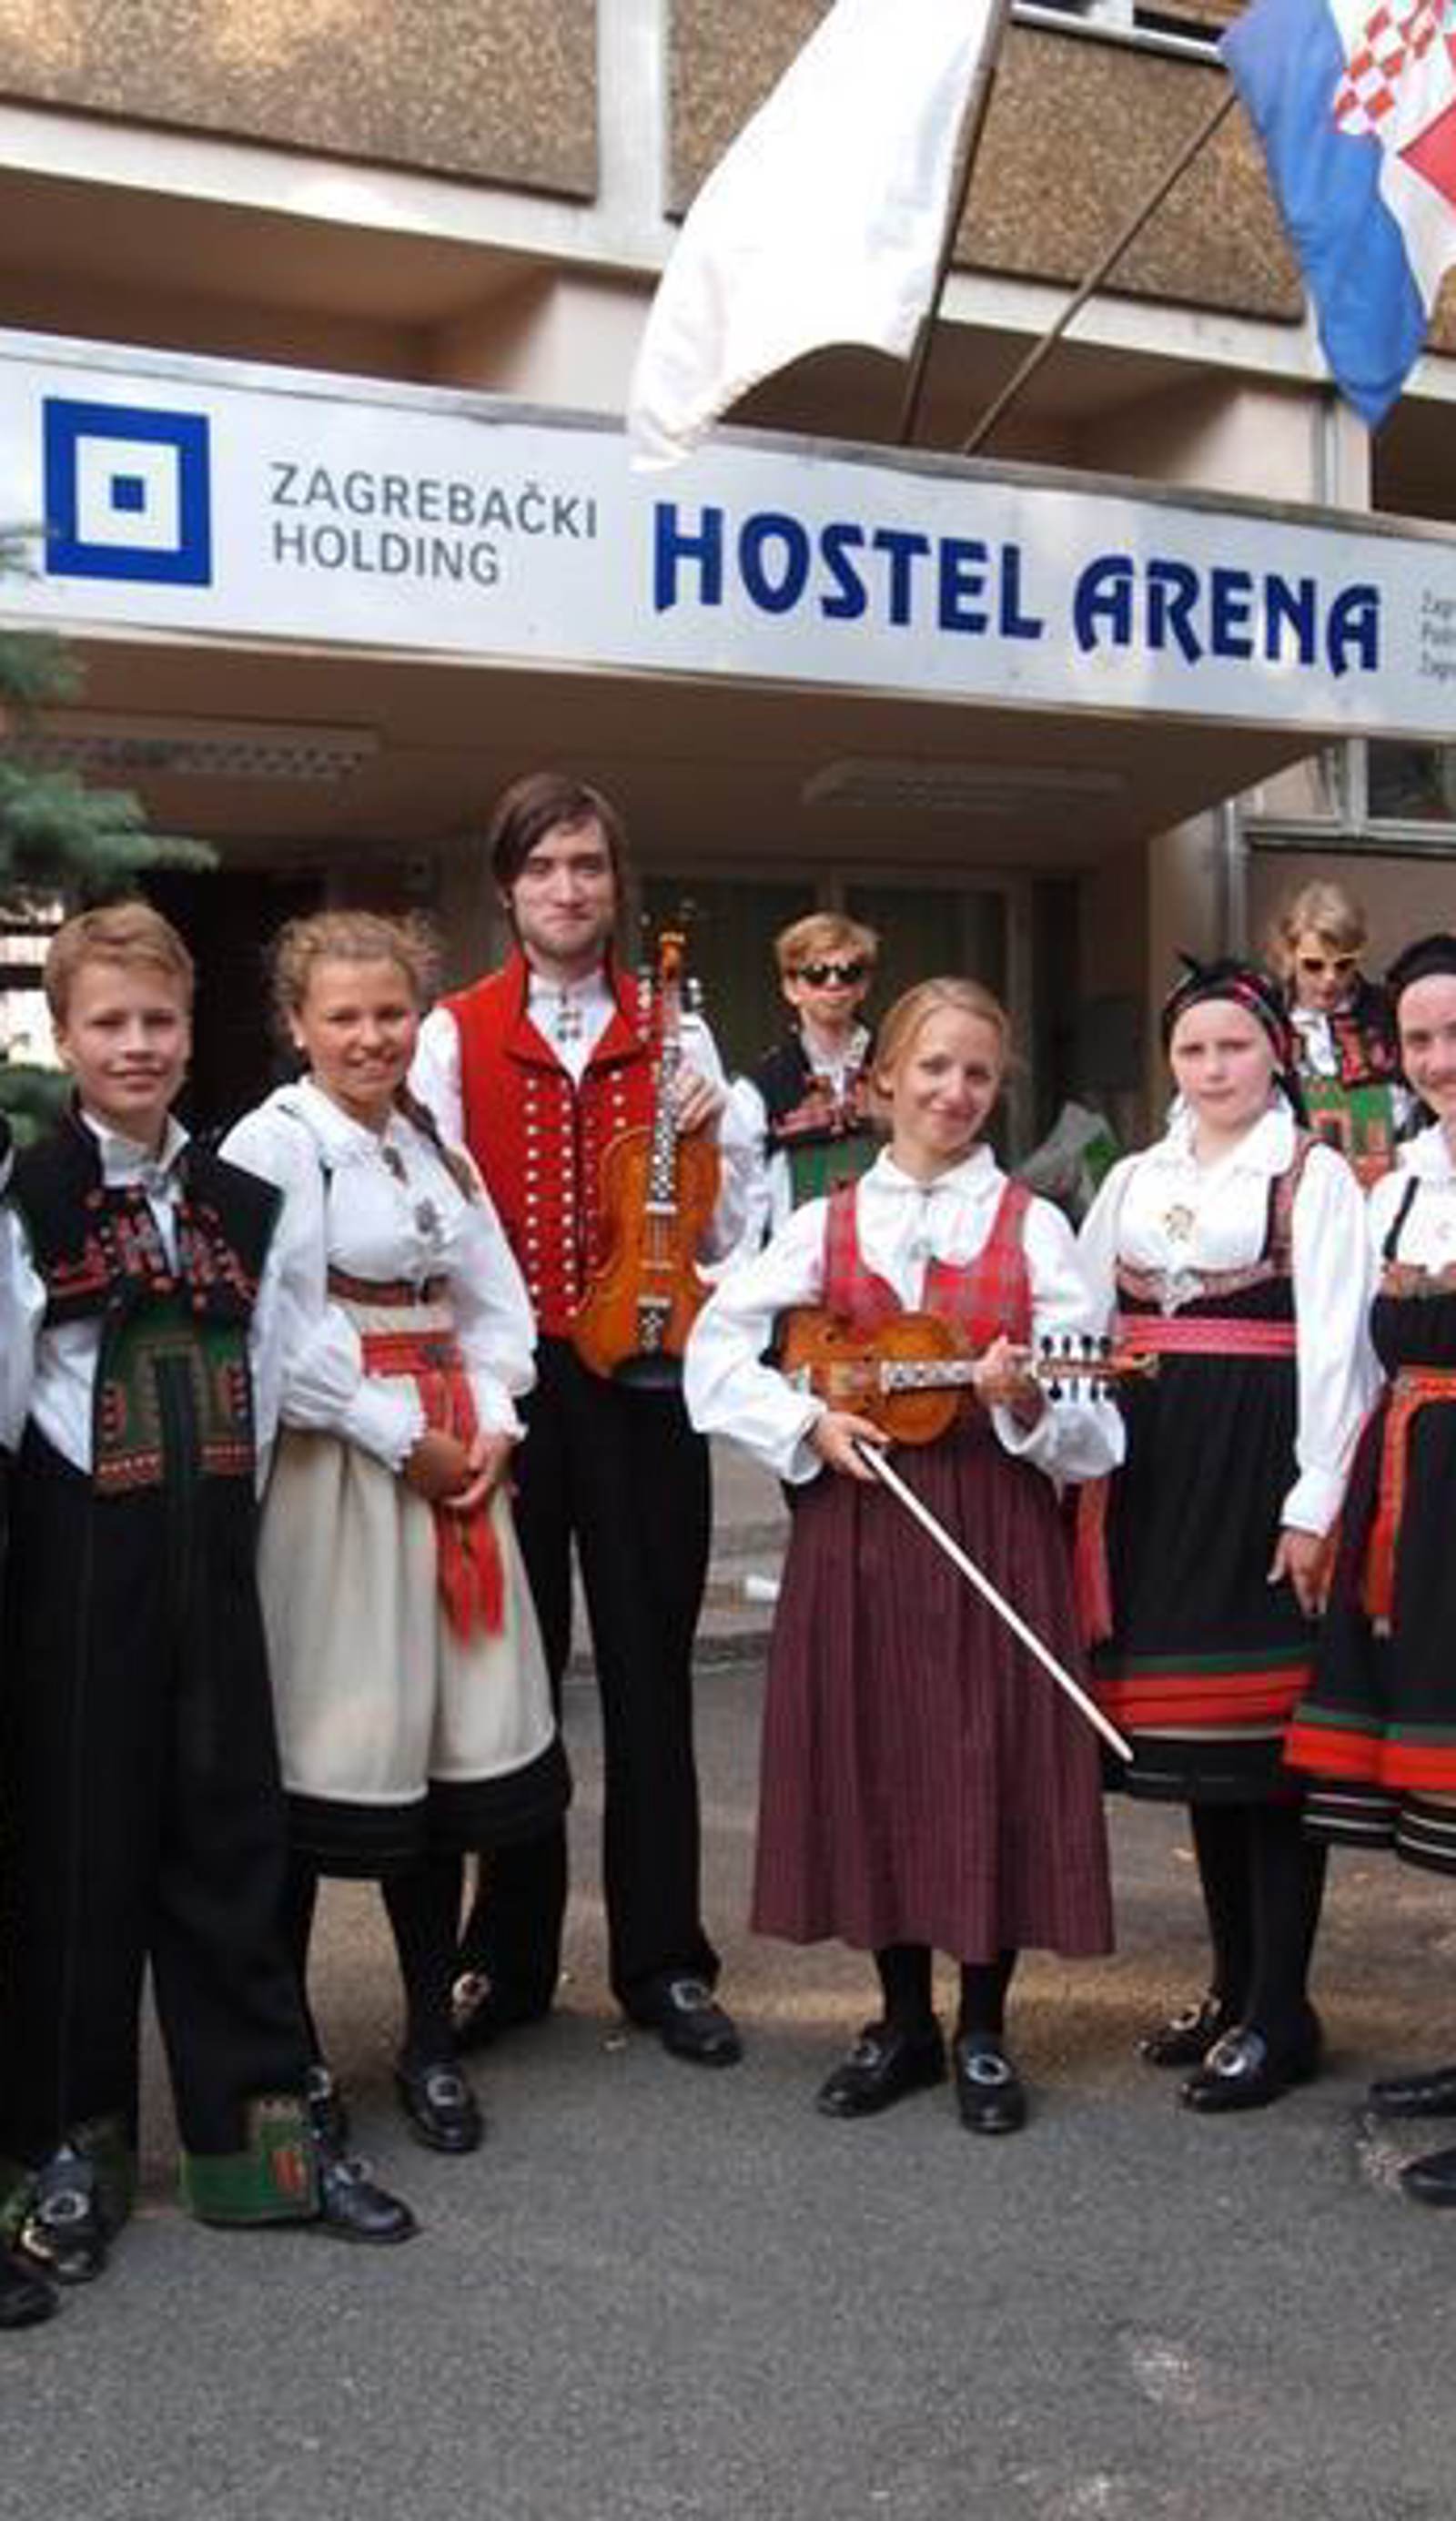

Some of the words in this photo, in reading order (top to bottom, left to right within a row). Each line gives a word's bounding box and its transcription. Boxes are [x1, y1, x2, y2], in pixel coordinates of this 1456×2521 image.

[271, 461, 597, 539] ZAGREBAČKI
[273, 521, 500, 587] HOLDING
[654, 502, 1044, 641] HOSTEL
[1075, 555, 1380, 675] ARENA
